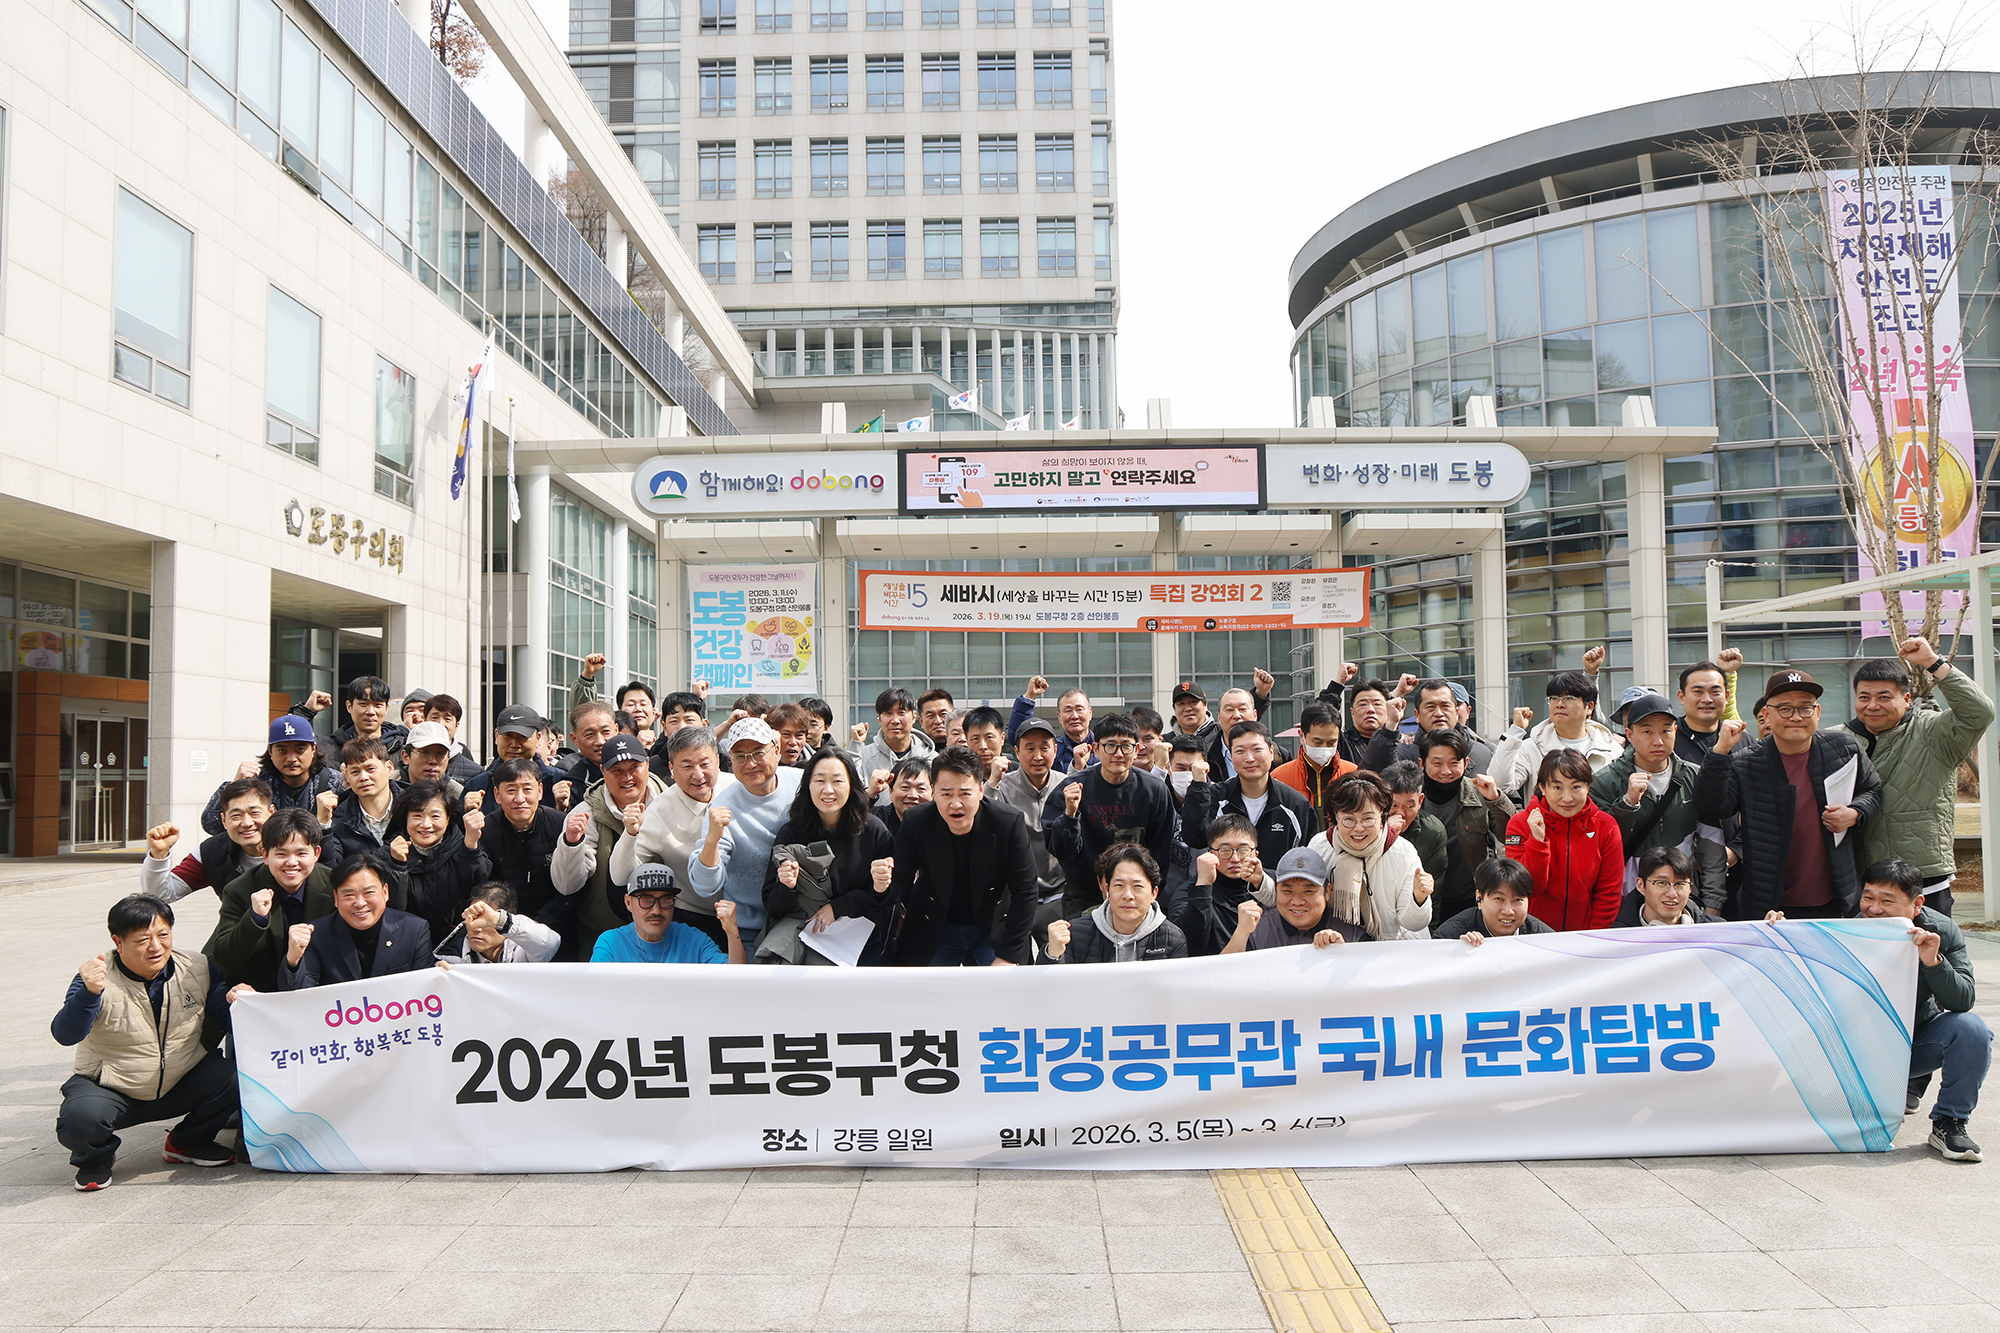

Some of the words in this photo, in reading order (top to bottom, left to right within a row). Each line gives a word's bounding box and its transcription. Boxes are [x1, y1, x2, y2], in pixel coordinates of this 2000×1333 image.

[1921, 175, 1947, 190] 주관
[1842, 198, 1944, 227] 2025년
[962, 468, 979, 476] 109
[1042, 458, 1058, 467] 삶의
[1061, 458, 1087, 466] 희망이
[1089, 457, 1115, 466] 보이지
[1117, 457, 1134, 466] 않을
[1448, 459, 1494, 488] 도봉
[1894, 445, 1941, 499] A
[699, 469, 783, 497] 함께해요!
[790, 469, 884, 493] dobong
[994, 472, 1061, 487] 고민하지
[1067, 471, 1101, 486] 말고
[1110, 470, 1196, 486] 연락주세요
[308, 507, 404, 574] 도봉구의회
[708, 573, 731, 582] 도봉구민
[749, 573, 766, 582] 건강한
[907, 583, 928, 608] 15
[1042, 590, 1080, 603] 바꾸는
[1084, 590, 1108, 603] 시간
[1150, 583, 1185, 603] 특집
[1190, 583, 1245, 603] 강연회
[1250, 586, 1263, 601] 2
[693, 590, 747, 626] 도봉
[952, 613, 975, 621] 2026.
[1015, 613, 1031, 621] 19시
[1036, 612, 1069, 621] 도봉구청
[1071, 612, 1085, 621] 2층
[1086, 612, 1119, 621] 선인봉홀
[693, 629, 744, 660] 건강
[694, 663, 752, 689] 캠페인
[284, 721, 296, 735] LA
[1088, 804, 1135, 816] UNSPOKEN
[324, 993, 443, 1028] dobong
[270, 1048, 304, 1070] 같이
[310, 1040, 351, 1064] 변화,
[353, 1028, 412, 1057] 행복한
[417, 1023, 444, 1047] 도봉
[451, 1034, 691, 1104] 2026년
[708, 1029, 960, 1096] 도봉구청
[979, 1021, 1300, 1093] 환경공무관
[1319, 1010, 1444, 1080] 국내
[1461, 1001, 1720, 1077] 문화탐방
[762, 1128, 808, 1152] 장소
[833, 1128, 879, 1152] 강릉
[887, 1128, 933, 1151] 일원
[999, 1127, 1046, 1148] 일시
[1071, 1124, 1141, 1146] 2026.
[1147, 1121, 1170, 1143] 3.
[1176, 1117, 1234, 1141] 5(목)
